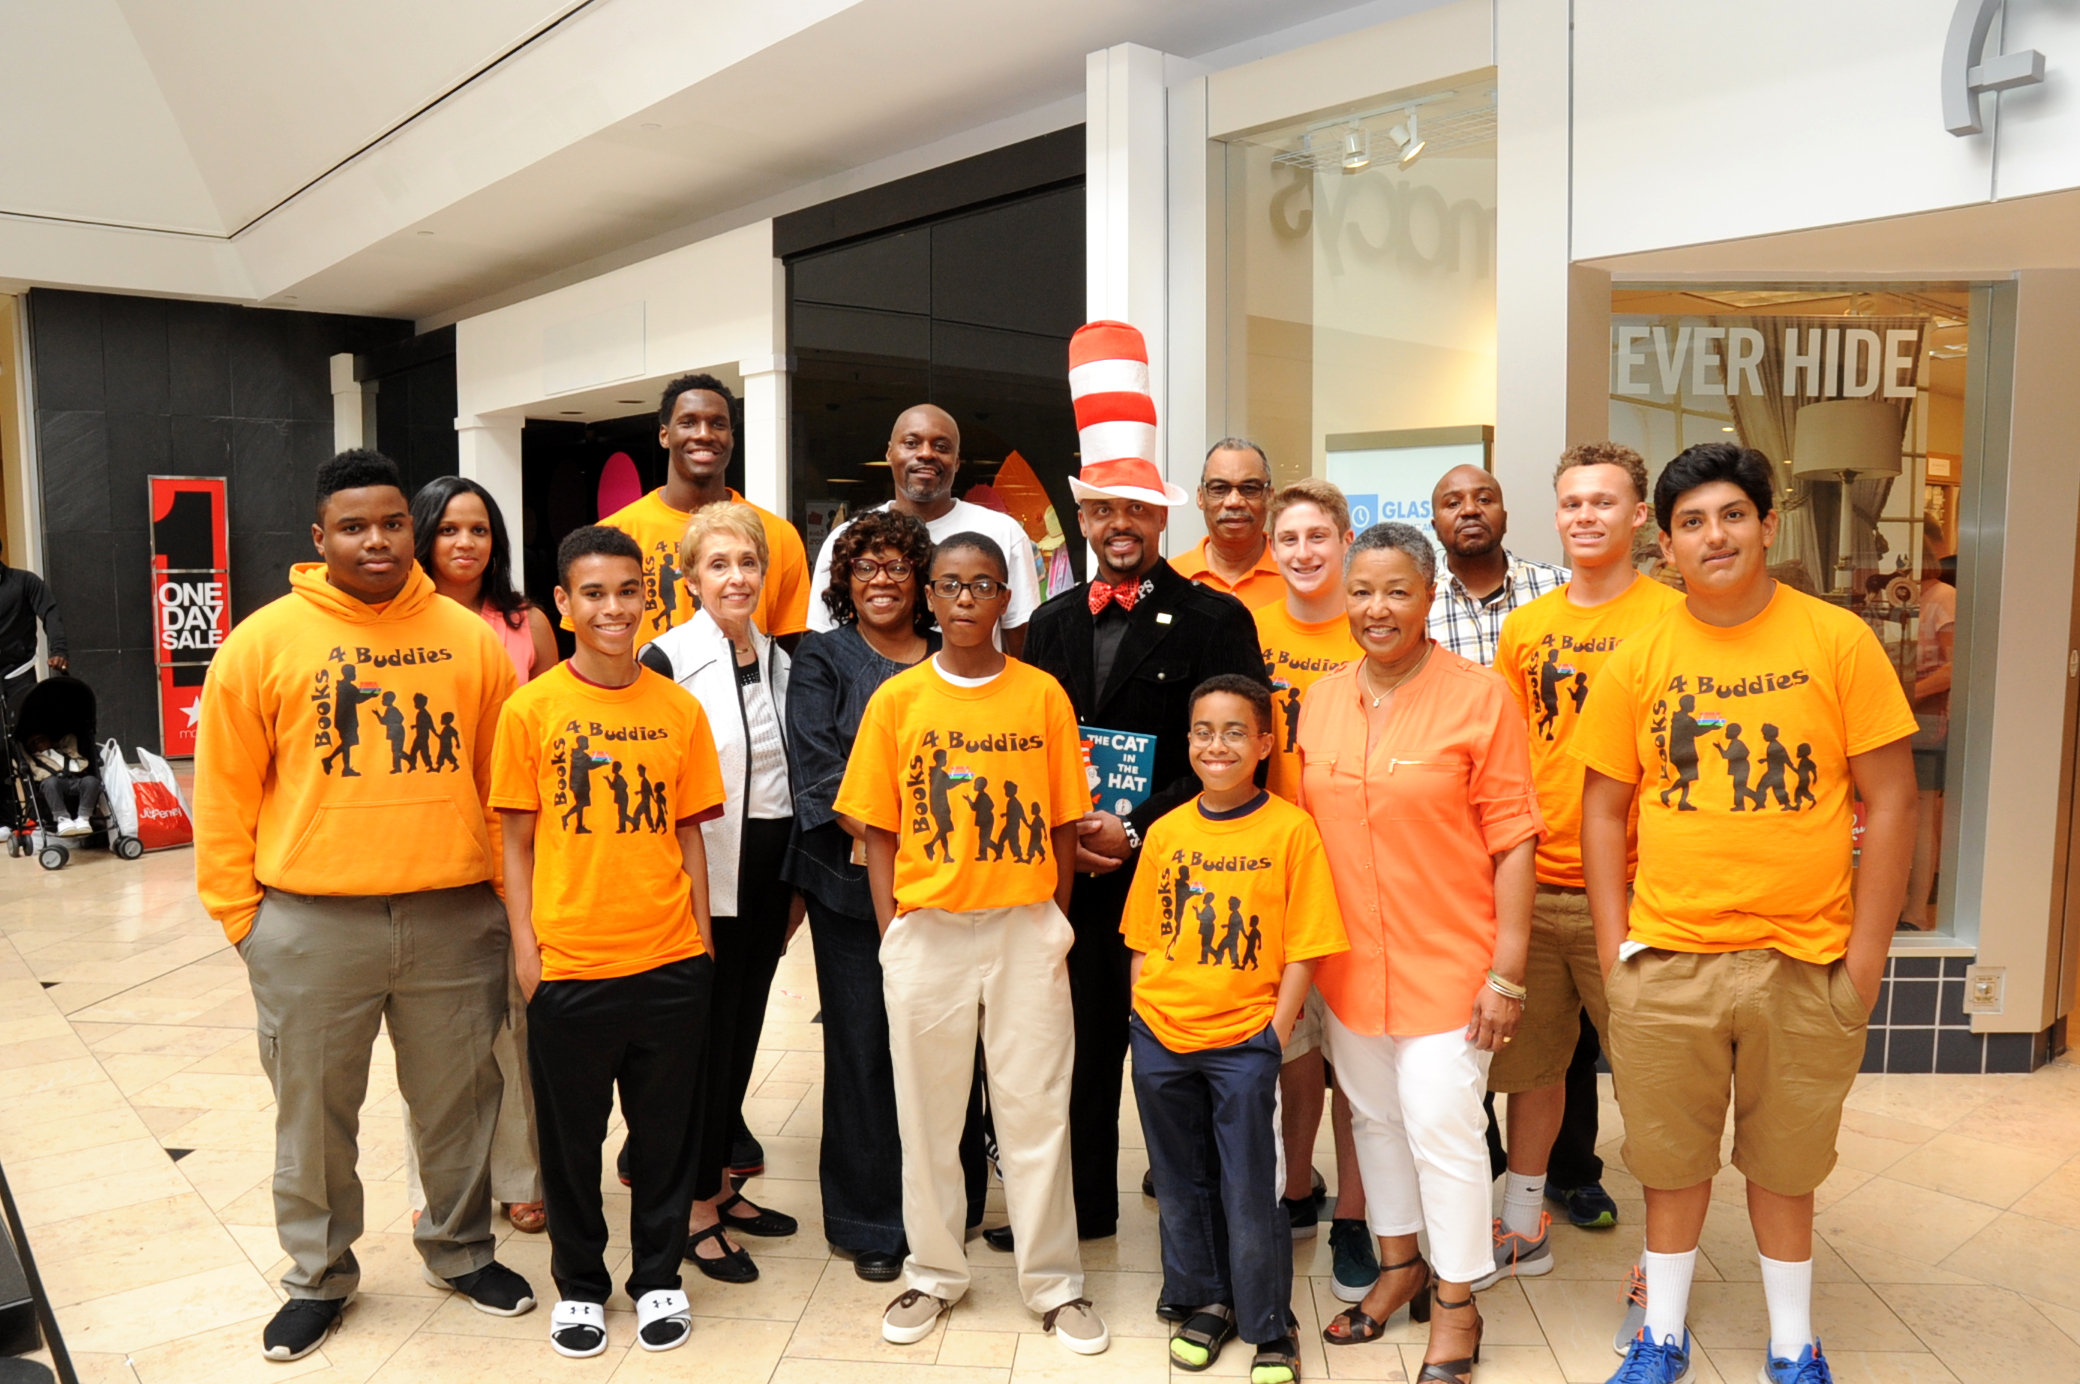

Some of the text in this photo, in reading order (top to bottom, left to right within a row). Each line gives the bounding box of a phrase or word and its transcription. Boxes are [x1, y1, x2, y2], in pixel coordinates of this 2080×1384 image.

[1609, 326, 1918, 398] EVER HIDE
[1382, 500, 1433, 519] GLAS
[643, 541, 668, 611] Books 4
[159, 582, 224, 607] ONE
[162, 606, 224, 630] DAY
[162, 630, 223, 650] SALE
[1541, 633, 1555, 648] 4
[1561, 635, 1623, 653] Buddi
[1262, 648, 1274, 661] 4
[1668, 674, 1688, 694] 4
[1696, 669, 1810, 699] Buddies
[311, 646, 453, 748] Books 4 Buddies
[1087, 734, 1149, 753] THE CAT
[551, 720, 668, 807] Books 4 Buddies
[1117, 763, 1139, 774] THE
[1122, 753, 1136, 763] IN
[907, 730, 1044, 834] Books 4 Buddies
[1107, 773, 1147, 792] HAT
[1158, 849, 1272, 936] Books 4 Buddies
